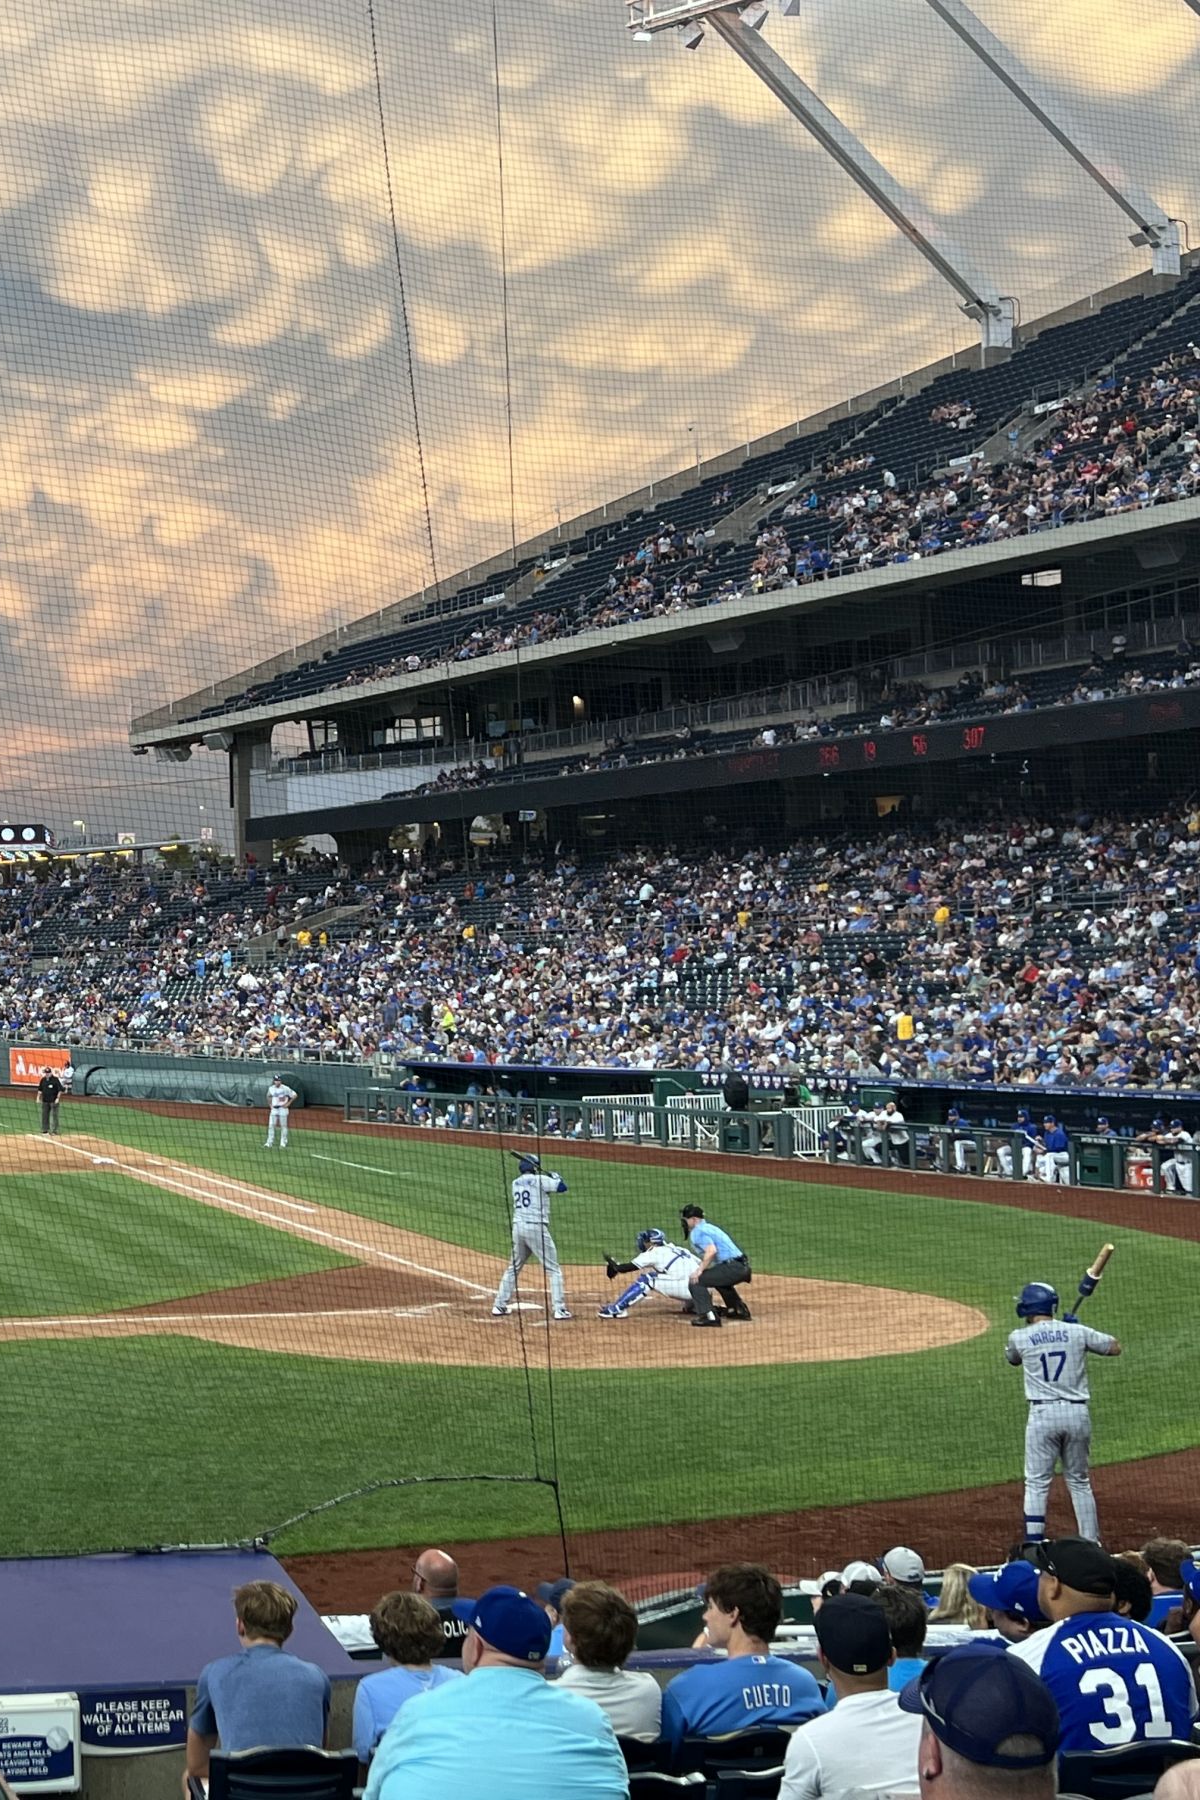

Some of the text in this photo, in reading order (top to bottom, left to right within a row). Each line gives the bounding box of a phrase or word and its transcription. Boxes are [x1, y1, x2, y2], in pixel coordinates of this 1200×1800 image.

[514, 1190, 531, 1208] 28
[1028, 1330, 1070, 1346] VARGAS
[1040, 1351, 1067, 1382] 17
[1060, 1628, 1150, 1664] PIAZZA
[742, 1684, 791, 1710] CUETO
[1079, 1663, 1173, 1745] 31
[95, 1699, 170, 1713] PLEASE KEEP
[82, 1710, 184, 1725] WALL TOPS CLEAR
[97, 1721, 170, 1736] OF ALL ITEMS
[2, 1741, 31, 1749] BEWARE
[13, 1750, 28, 1758] AND
[29, 1749, 52, 1757] BALLS
[0, 1759, 30, 1767] LEAVING
[28, 1767, 48, 1775] FIELD
